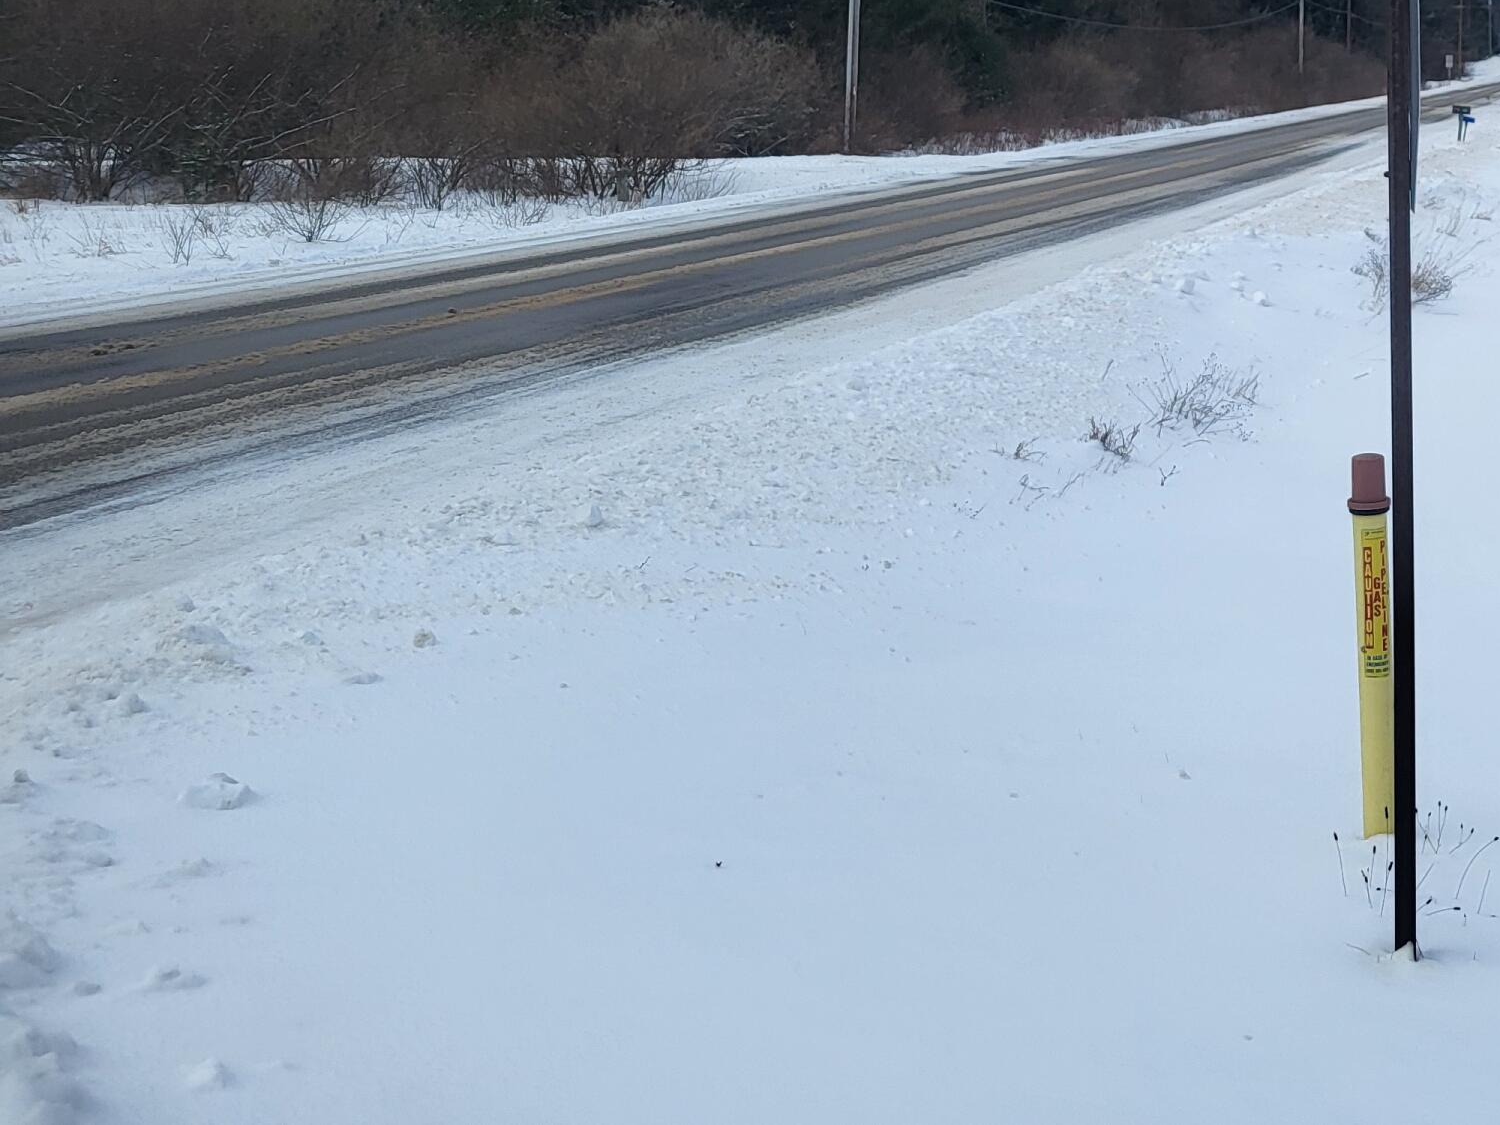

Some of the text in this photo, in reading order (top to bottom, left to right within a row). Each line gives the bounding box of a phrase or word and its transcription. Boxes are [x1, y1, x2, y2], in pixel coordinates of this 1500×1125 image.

[1364, 548, 1374, 648] CAUTION
[1373, 577, 1381, 617] GAS
[1380, 539, 1388, 651] PIPELINE
